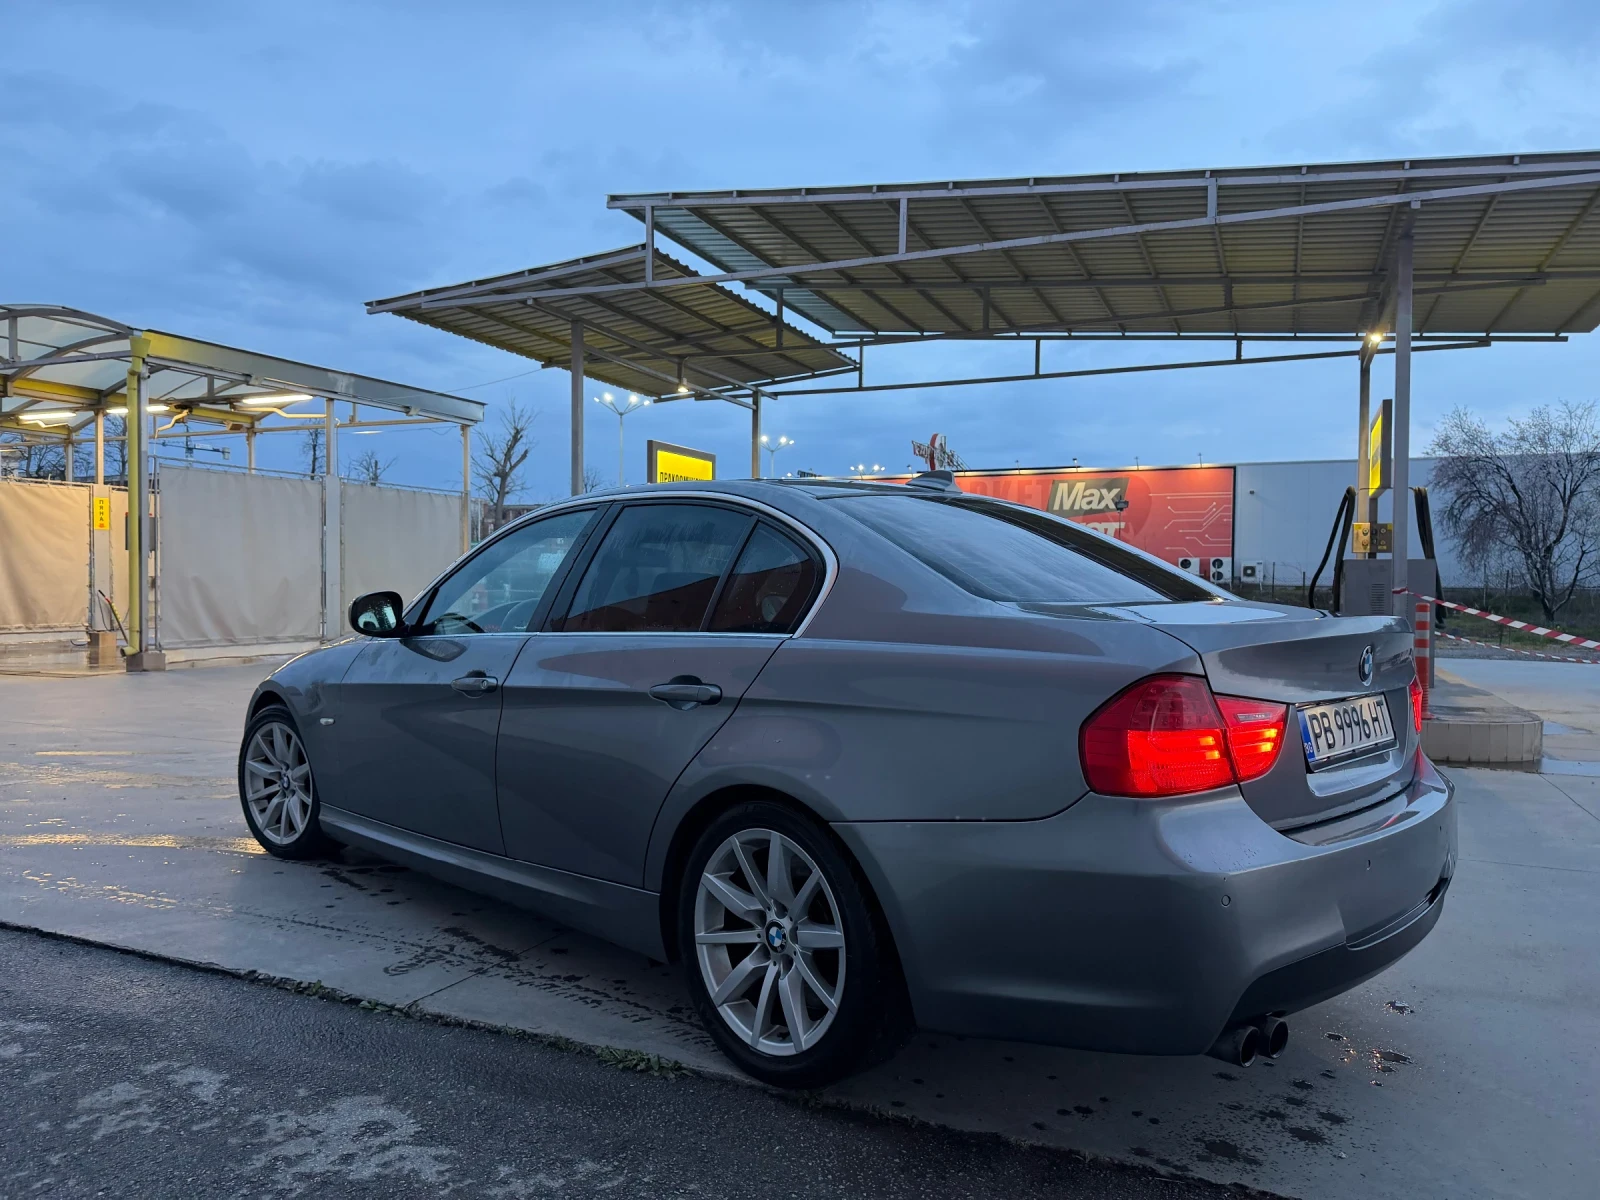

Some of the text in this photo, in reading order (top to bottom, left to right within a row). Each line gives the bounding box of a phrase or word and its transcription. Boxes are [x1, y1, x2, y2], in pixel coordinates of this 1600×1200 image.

[1053, 482, 1120, 511] Max
[1308, 700, 1389, 752] PB 9996 HT
